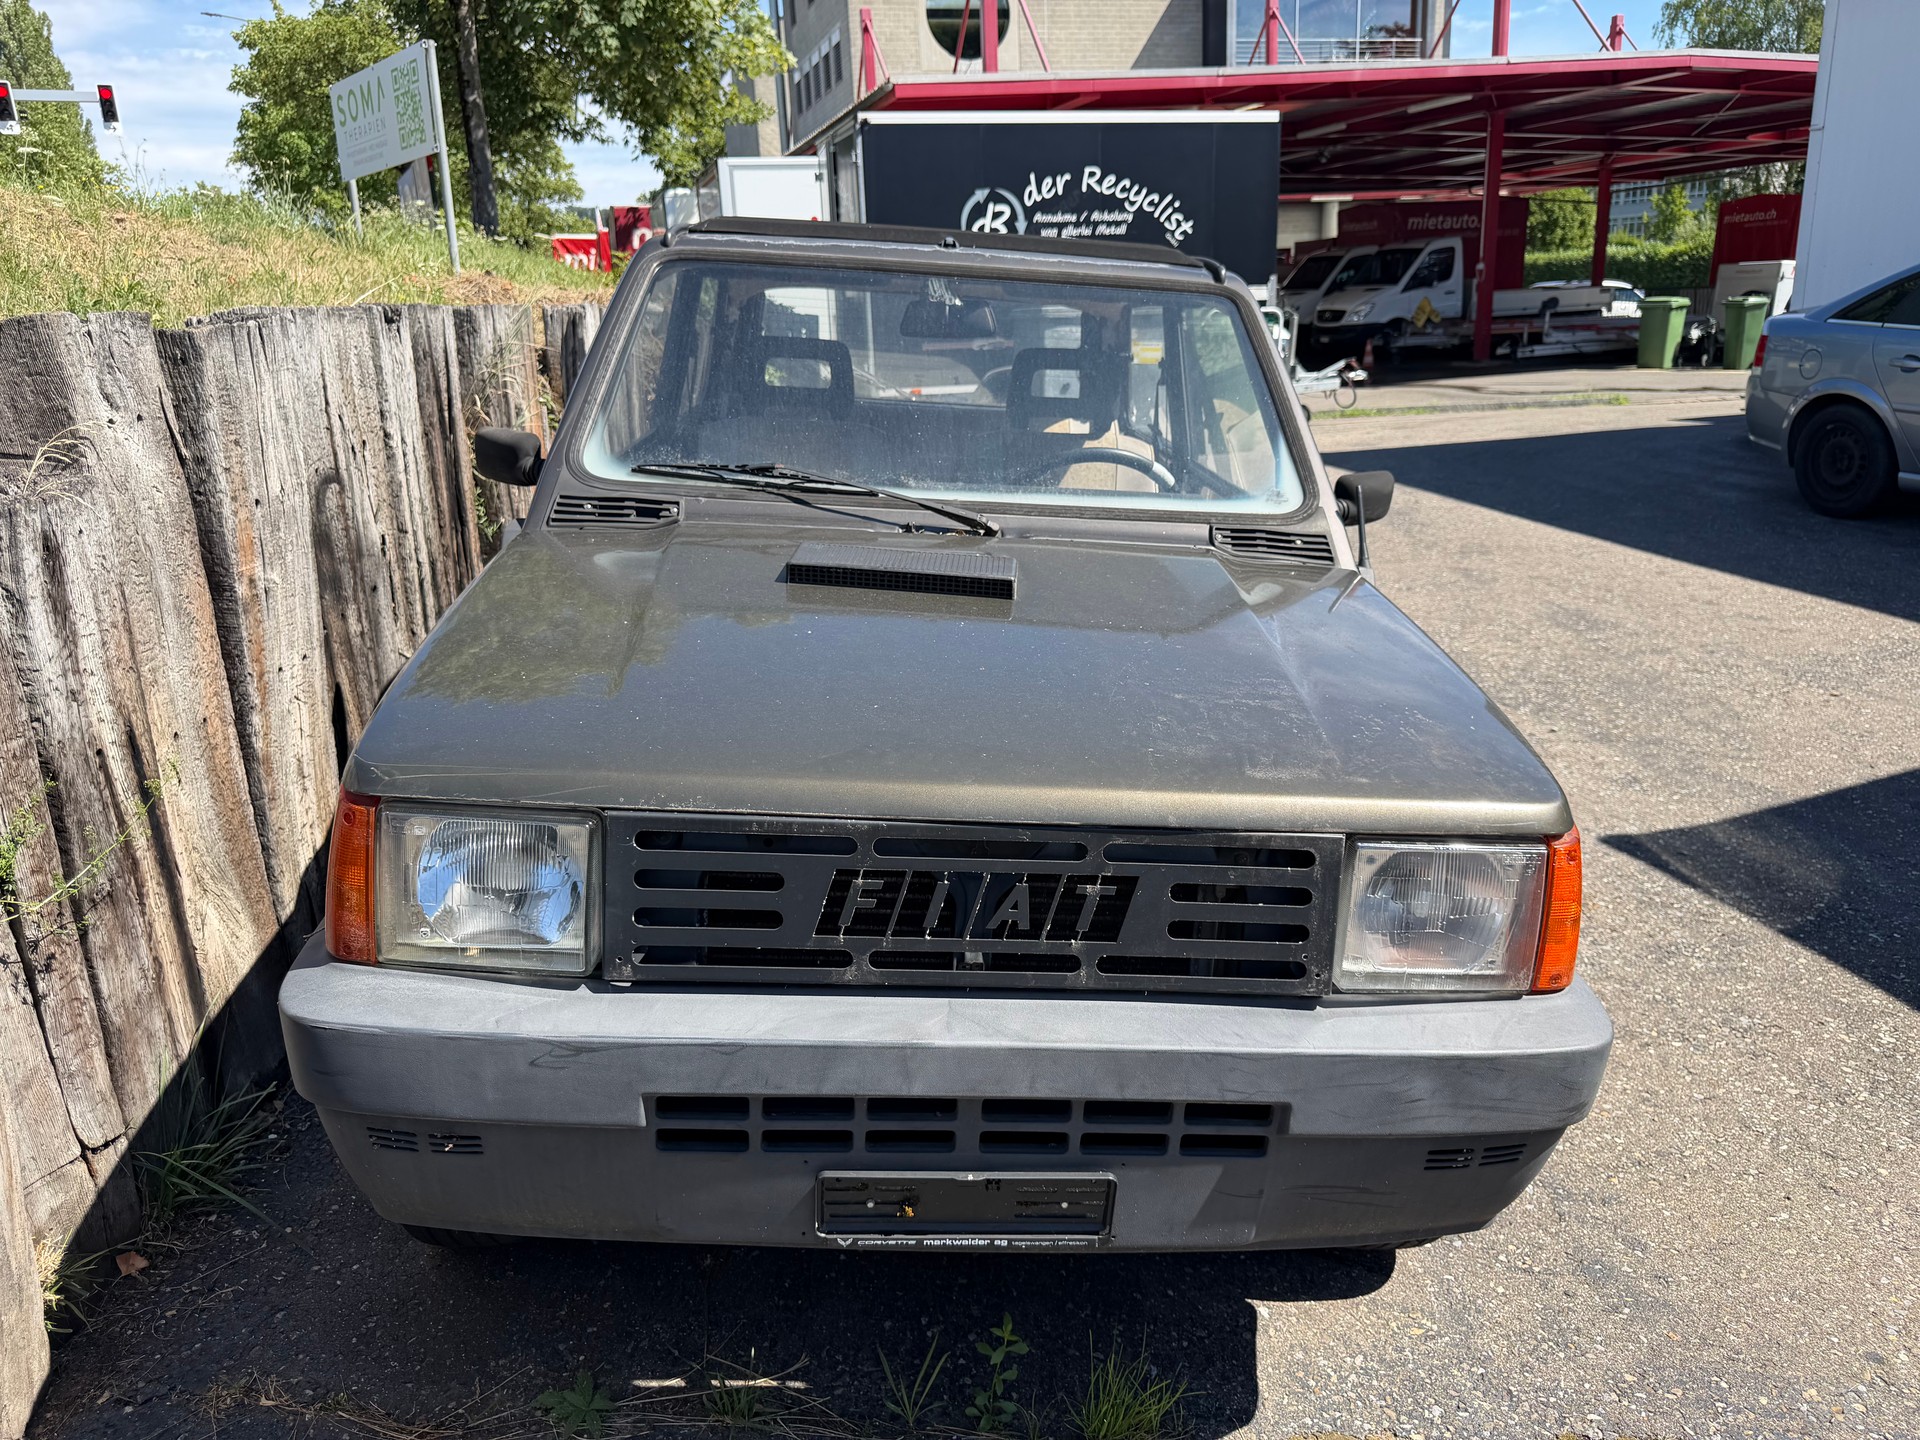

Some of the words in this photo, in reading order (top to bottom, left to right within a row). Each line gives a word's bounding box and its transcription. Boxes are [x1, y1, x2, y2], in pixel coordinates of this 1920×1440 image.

[344, 116, 387, 144] THERAPIEN
[1024, 171, 1071, 207] der
[1081, 165, 1194, 241] Recyclist
[1033, 210, 1078, 223] Annahme
[1090, 208, 1134, 224] Abholung
[1407, 211, 1481, 231] mietauto.
[1723, 208, 1777, 225] mietauto.ch
[1095, 222, 1128, 236] Metall
[838, 879, 1117, 932] FIAT
[923, 1238, 990, 1246] markwalder
[994, 1239, 1008, 1247] ag
